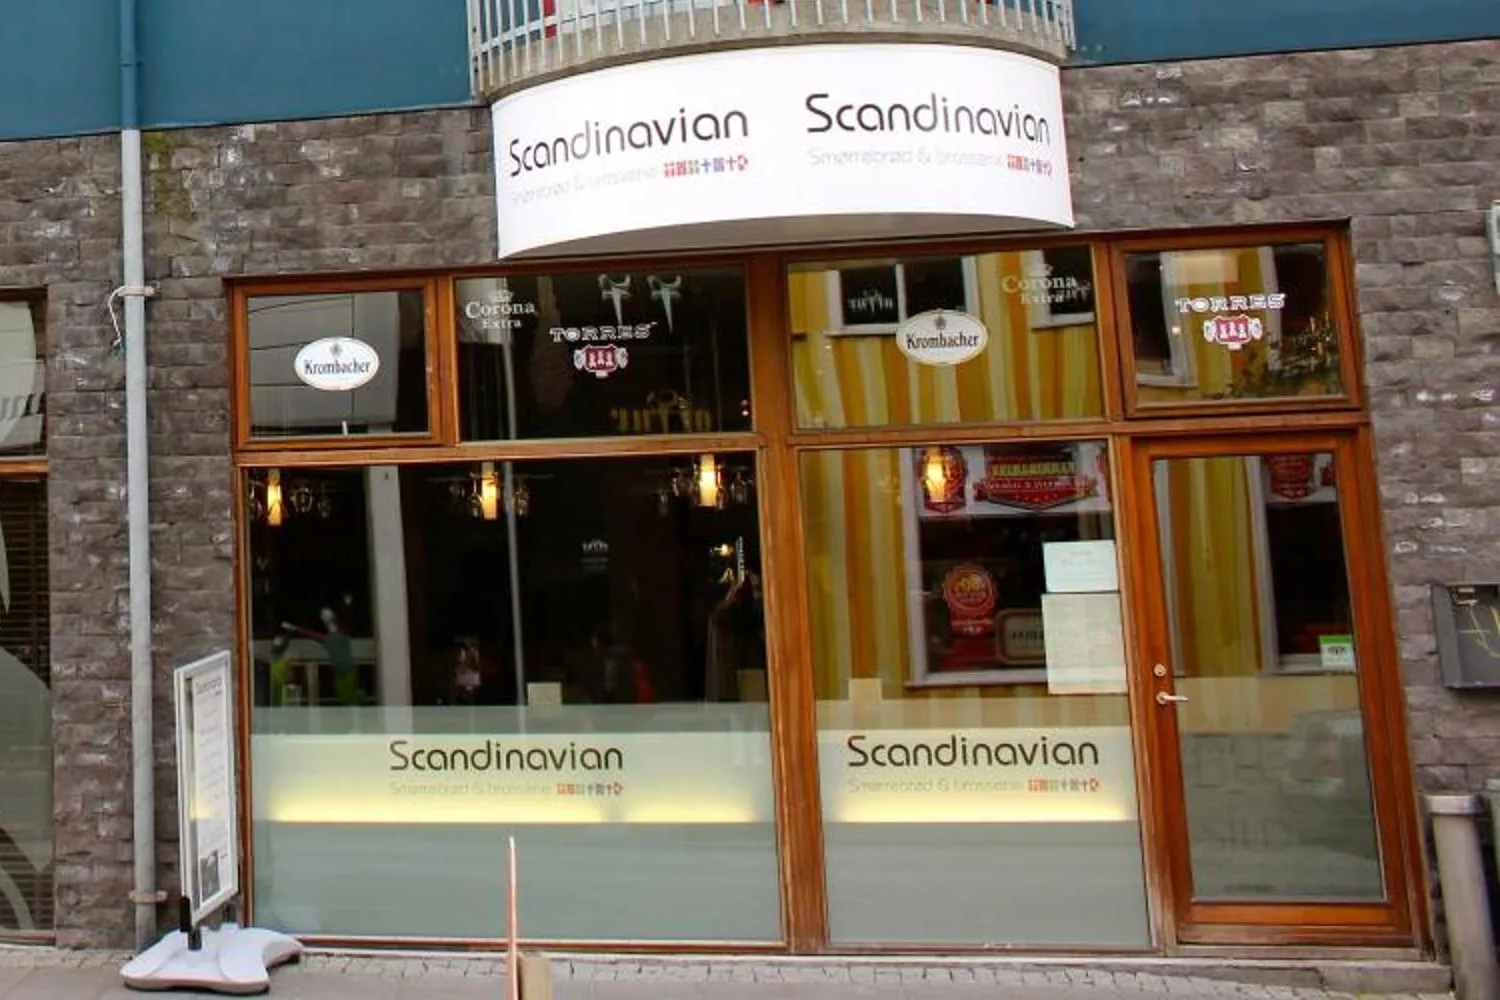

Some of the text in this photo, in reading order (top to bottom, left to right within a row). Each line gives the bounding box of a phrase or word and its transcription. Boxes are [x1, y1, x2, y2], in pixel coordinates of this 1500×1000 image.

[804, 92, 1051, 147] Scandinavian
[510, 106, 748, 178] Scandinavian
[1001, 275, 1077, 293] Corona
[465, 300, 536, 319] Corona
[1174, 293, 1287, 313] TORRES
[549, 322, 656, 343] TORRES
[906, 330, 980, 350] Krombacher
[304, 356, 371, 377] Krombacher
[389, 740, 623, 771] Scandinavian
[847, 735, 1100, 767] Scandinavian
